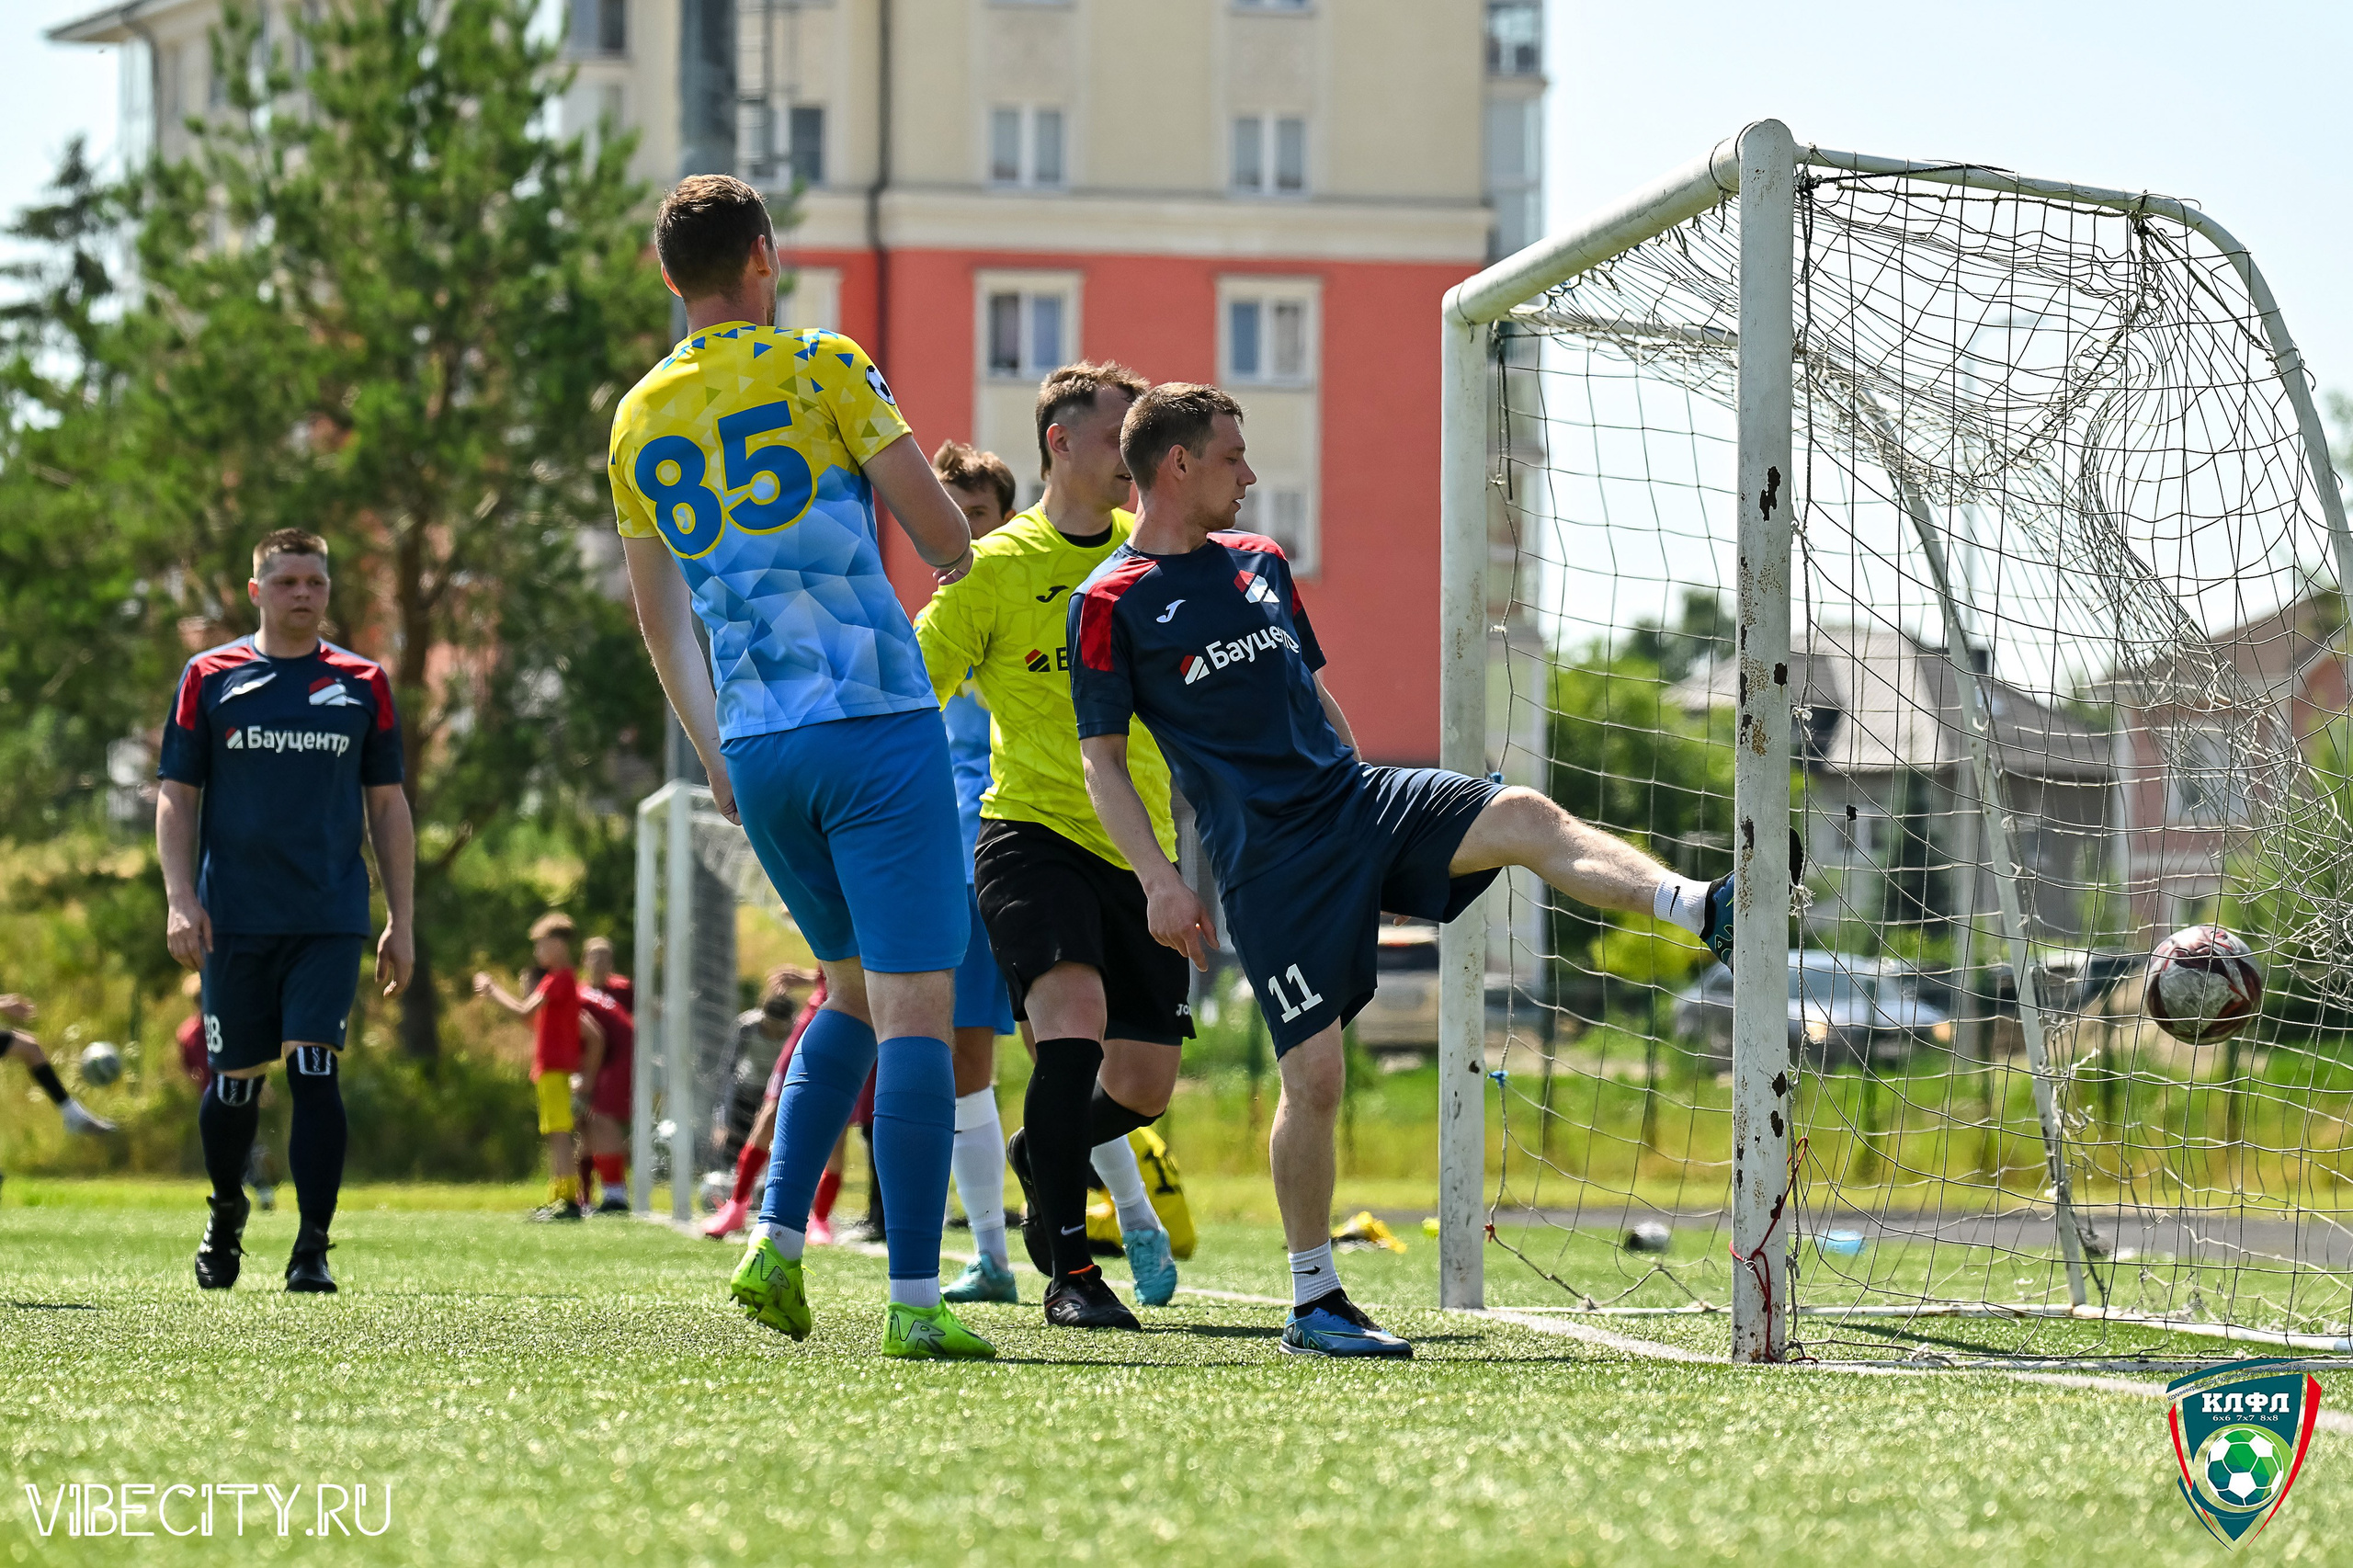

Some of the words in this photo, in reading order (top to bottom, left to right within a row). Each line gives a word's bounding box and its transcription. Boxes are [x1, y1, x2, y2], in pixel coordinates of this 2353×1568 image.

[634, 400, 813, 557] 85
[1206, 624, 1300, 670] Бауцентр
[247, 725, 349, 756] Бауцентр
[1267, 963, 1324, 1023] 11
